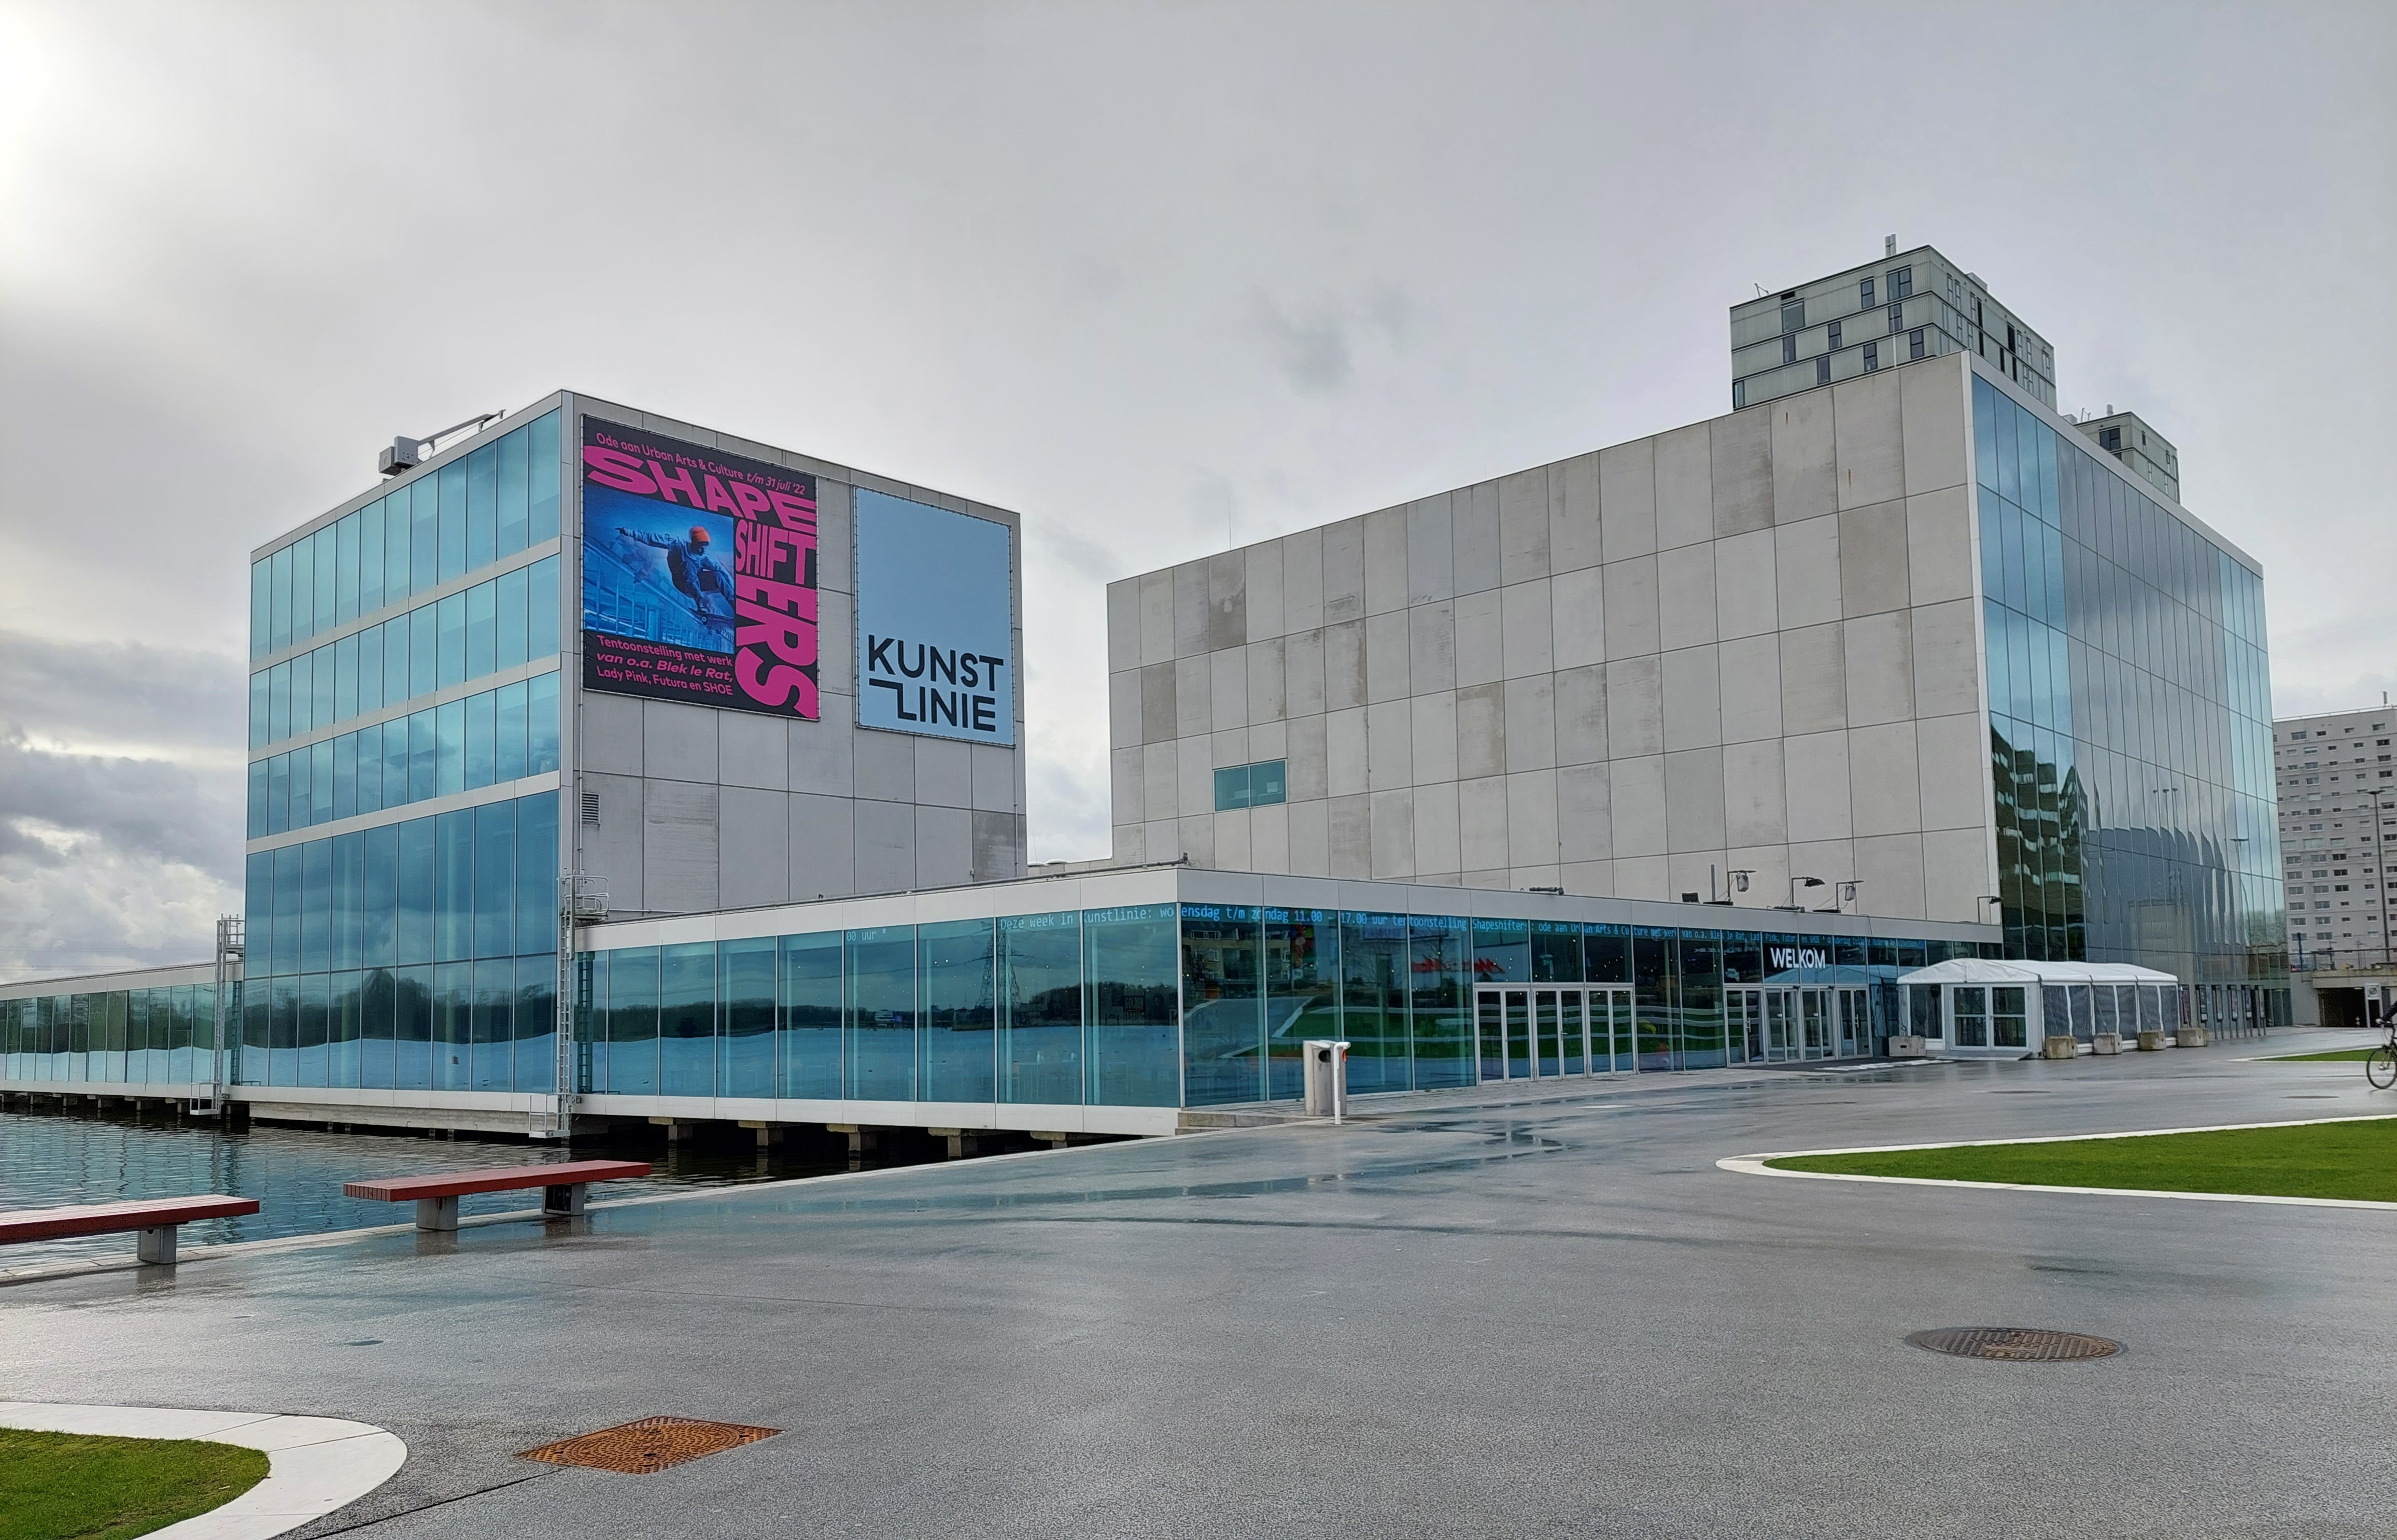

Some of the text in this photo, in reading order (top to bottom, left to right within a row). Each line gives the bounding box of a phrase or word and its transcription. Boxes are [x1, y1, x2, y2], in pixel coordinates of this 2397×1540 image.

[596, 432, 619, 448] Ode
[622, 441, 641, 454] aan
[642, 444, 673, 462] Urban
[675, 453, 698, 468] Arts
[698, 459, 707, 471] &
[708, 461, 743, 479] Culture
[746, 472, 764, 485] t/m
[765, 476, 776, 489] 31
[776, 479, 791, 491] juli
[583, 445, 816, 534] SHAPE
[736, 519, 816, 585] SHIFT
[597, 634, 733, 667] Tentoonstelling met werk
[868, 634, 1004, 691] KUNST
[597, 653, 734, 683] van o.a. Blek le Rat,
[597, 665, 733, 696] Lady Pink, Futura en SHOE
[869, 677, 996, 732] LINIE
[862, 931, 877, 940] uur
[1000, 917, 1024, 930] Deze
[1030, 914, 1055, 928] week
[1061, 912, 1073, 925] in
[1225, 906, 1245, 921] t/m
[1294, 910, 1323, 922] 11.00
[1341, 912, 1367, 924] 17.00
[1373, 916, 1388, 925] uur
[1538, 921, 1552, 932] ode
[1555, 923, 1568, 932] aan
[1596, 924, 1611, 935] Arts
[1613, 925, 1618, 935] &
[1621, 925, 1648, 936] Cuture
[1770, 948, 1826, 969] WELKOM
